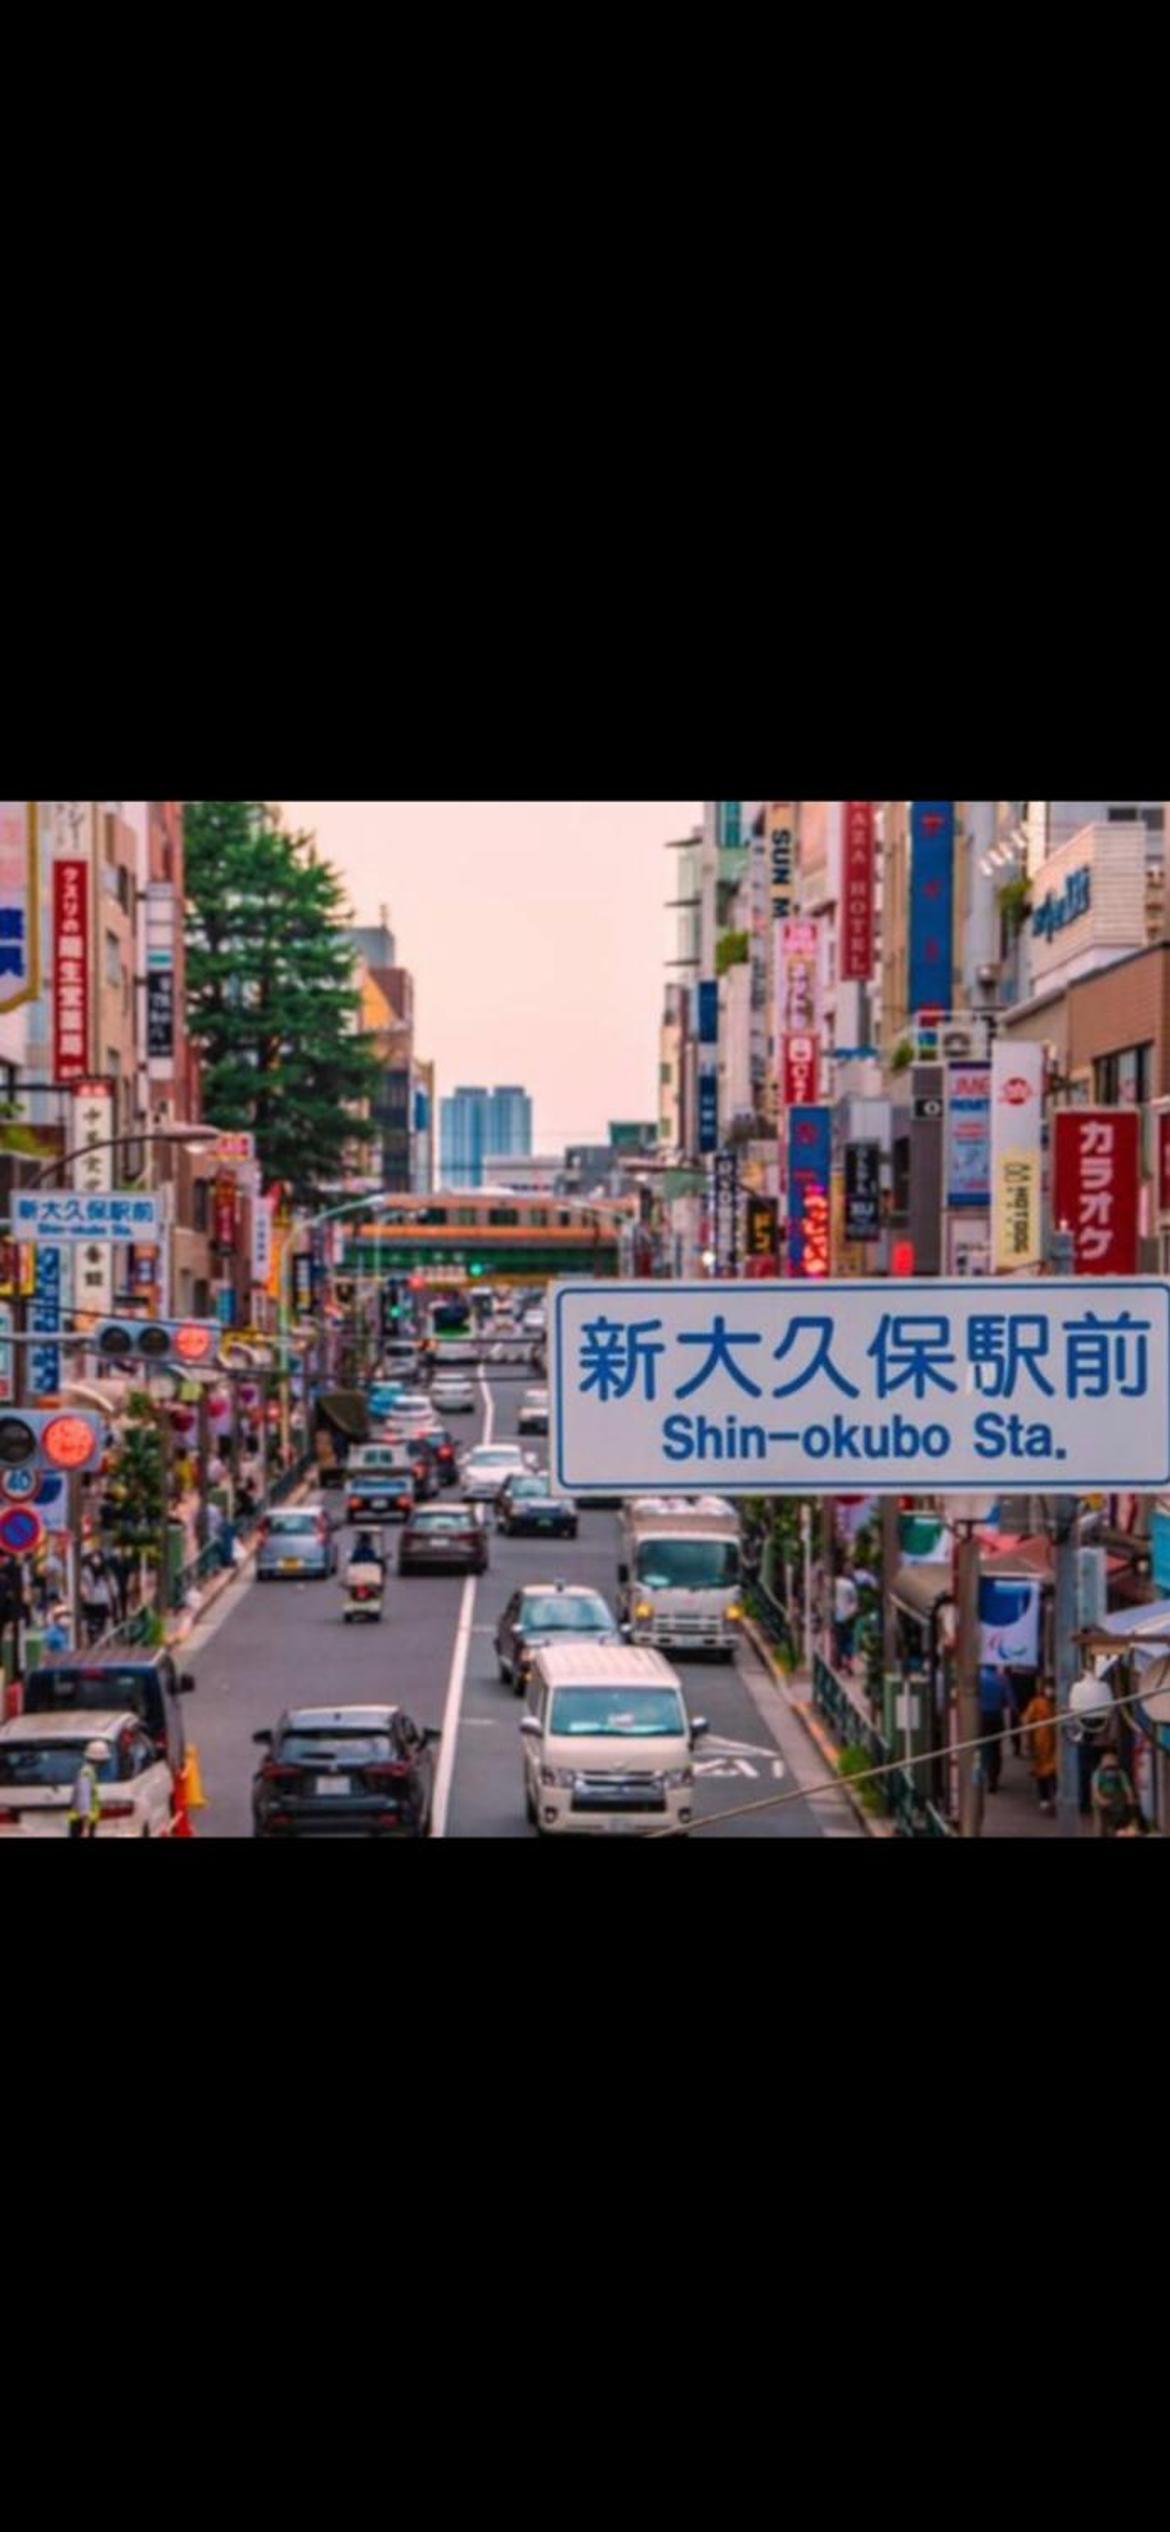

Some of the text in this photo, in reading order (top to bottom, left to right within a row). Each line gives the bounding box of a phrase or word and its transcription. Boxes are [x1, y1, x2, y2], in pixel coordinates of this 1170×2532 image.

[773, 829, 791, 885] SUN
[850, 882, 866, 972] HOTEL
[1080, 1121, 1113, 1260] カラオケ
[578, 1310, 1154, 1402] 新大久保駅前
[662, 1412, 1068, 1461] Shin-okubo Sta.
